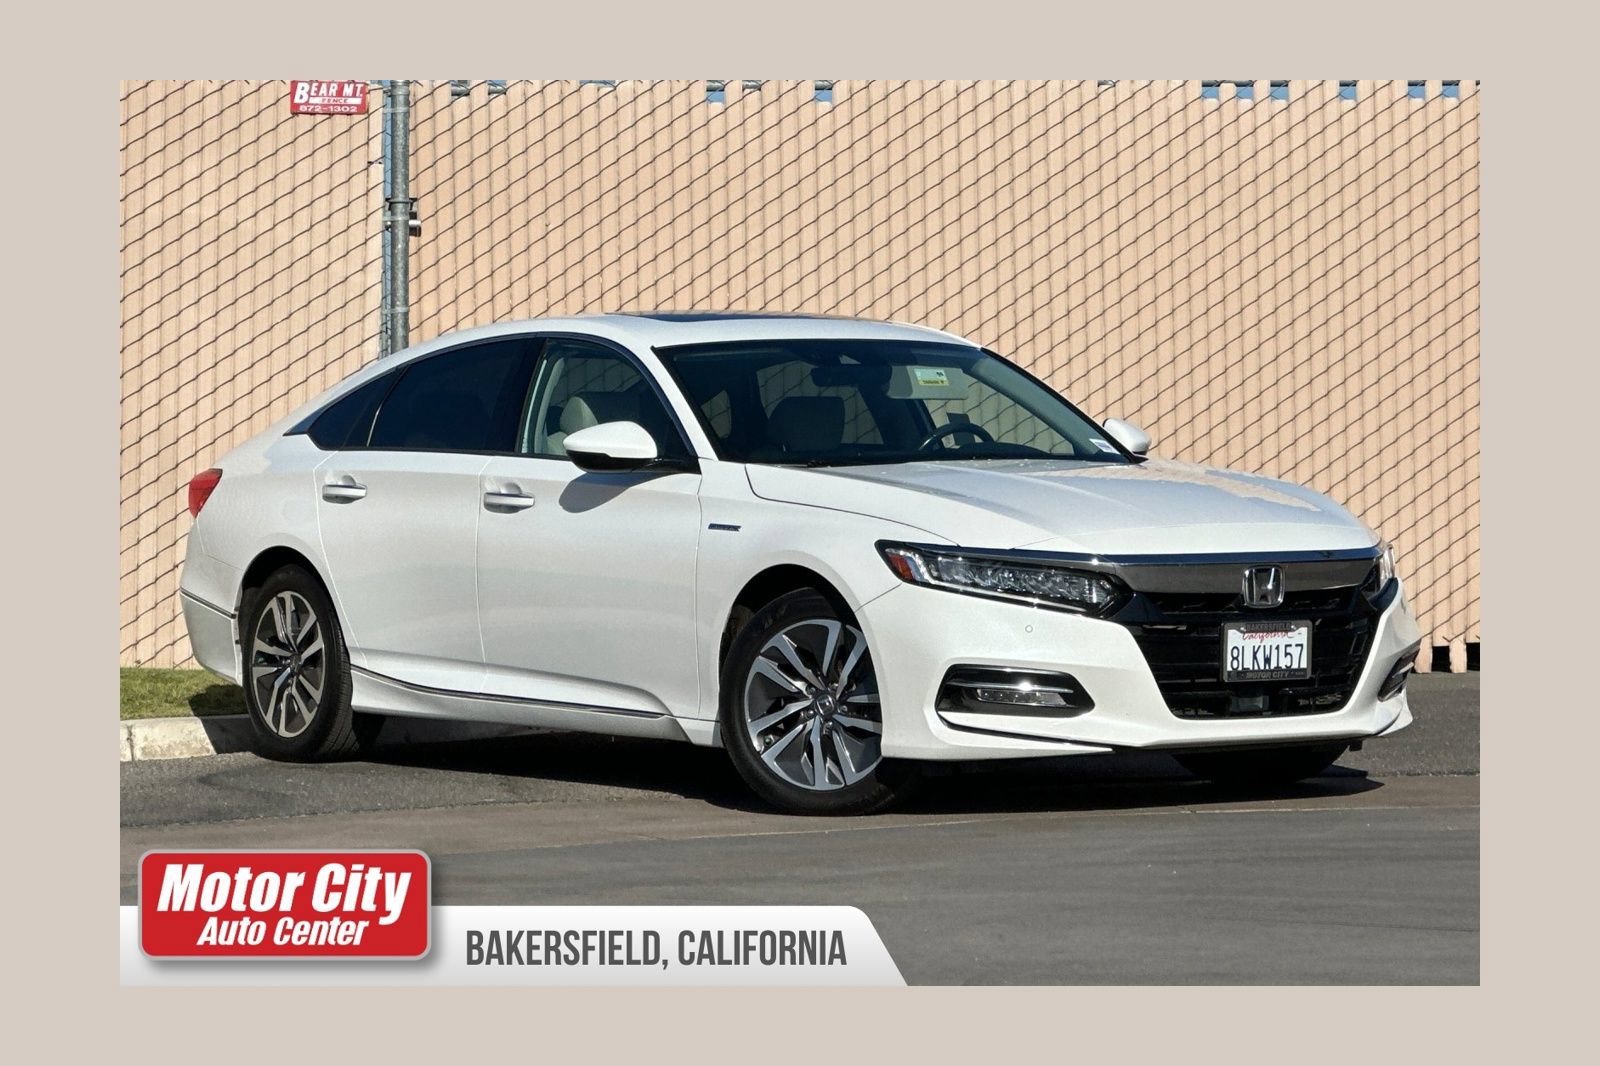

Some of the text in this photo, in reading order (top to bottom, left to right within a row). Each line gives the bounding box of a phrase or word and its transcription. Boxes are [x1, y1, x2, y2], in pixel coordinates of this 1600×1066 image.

[294, 82, 364, 104] BEAR MT.
[1230, 643, 1304, 671] 8LKW157
[1246, 671, 1271, 679] MOTOR
[1272, 670, 1290, 679] CITY
